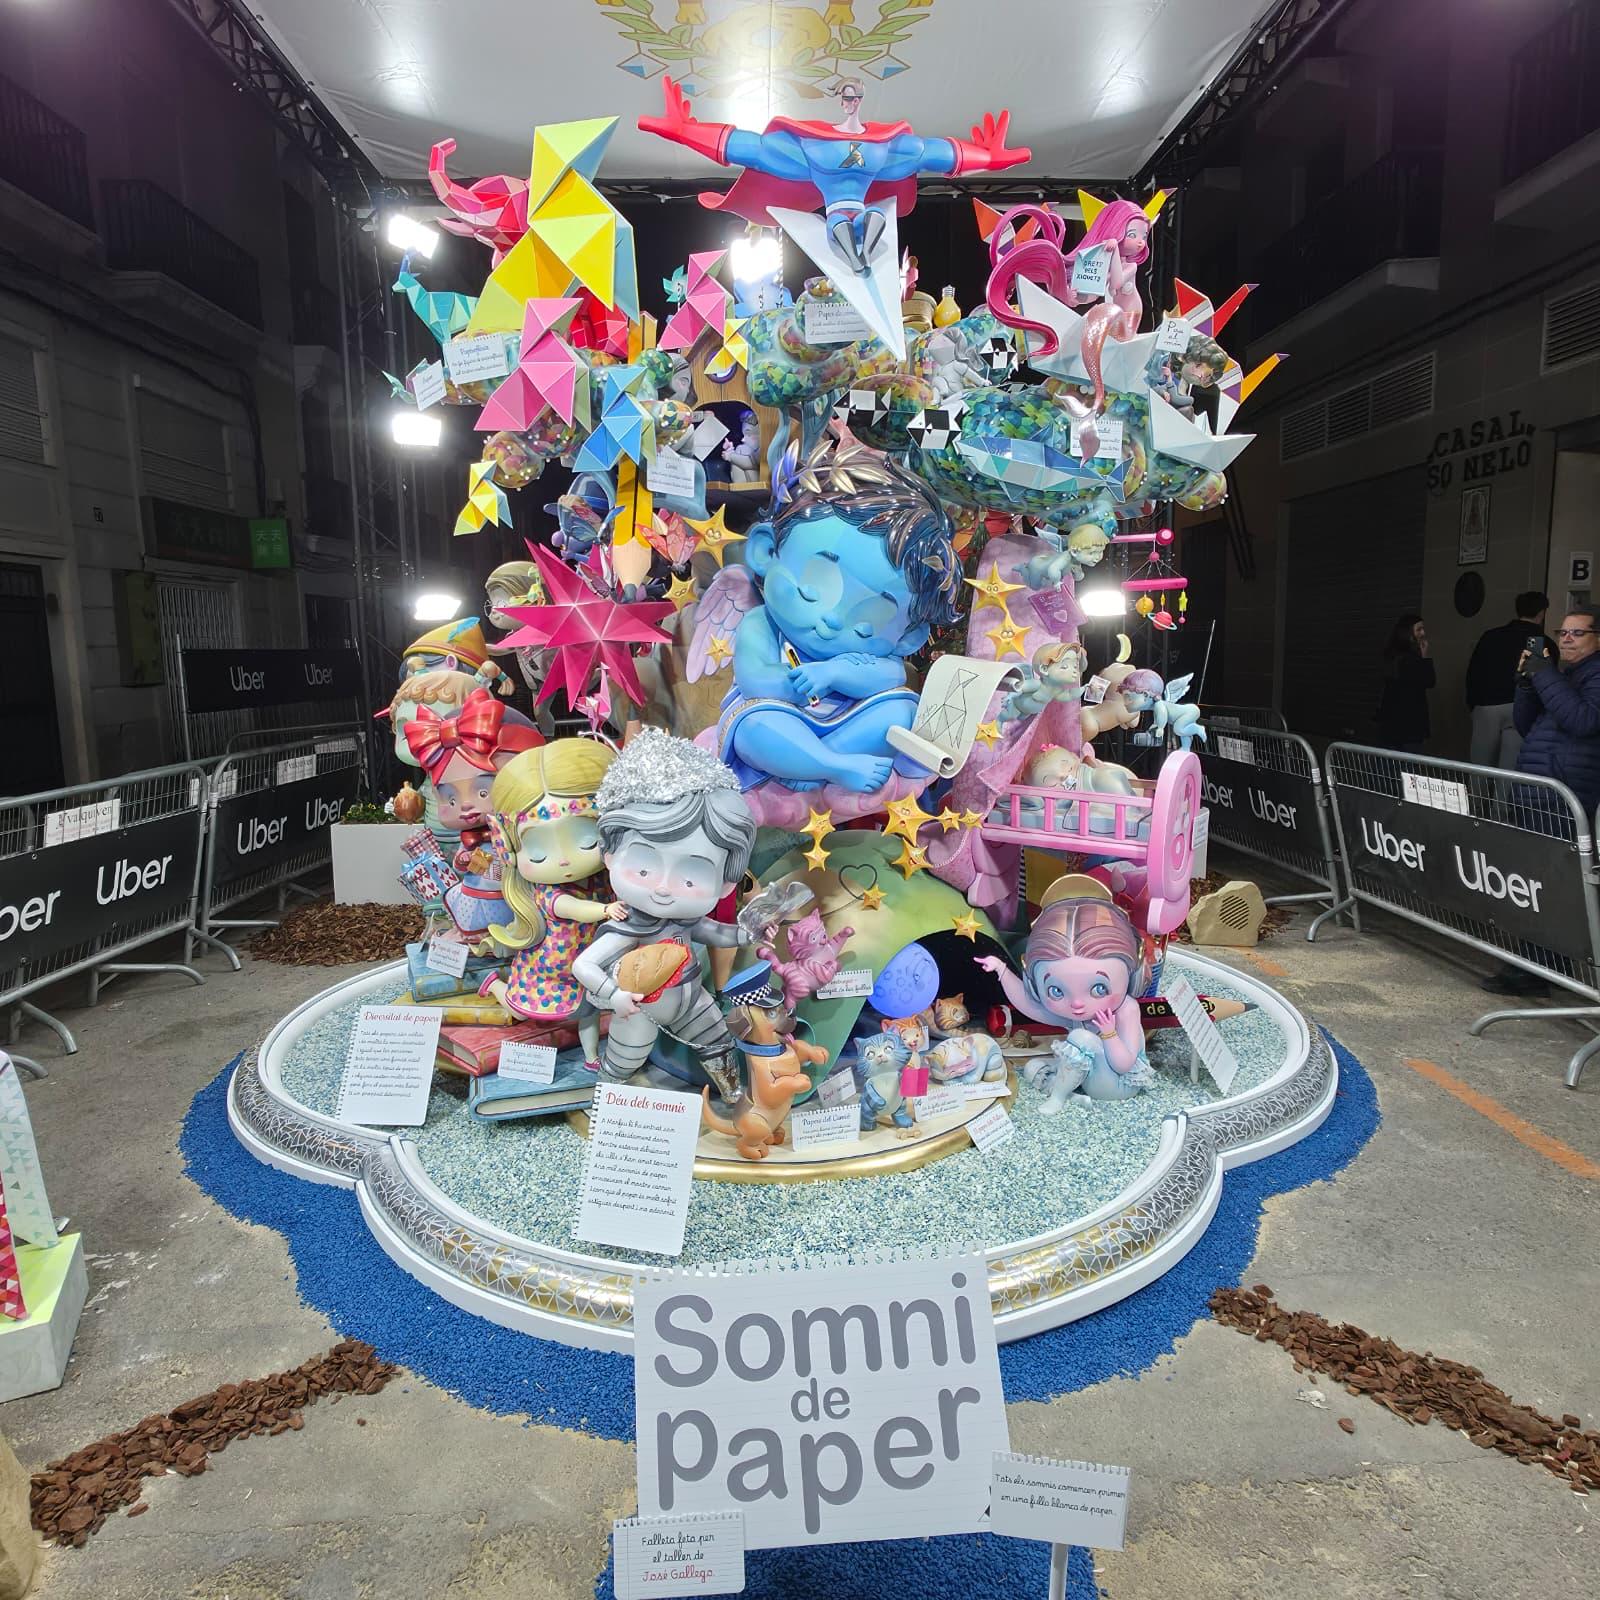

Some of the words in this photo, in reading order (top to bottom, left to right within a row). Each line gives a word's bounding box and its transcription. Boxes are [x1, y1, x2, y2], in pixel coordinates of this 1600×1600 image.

[1434, 410, 1527, 457] CASAL
[1571, 560, 1590, 581] B
[229, 665, 265, 691] Uber
[304, 663, 333, 686] Uber
[306, 797, 345, 831] Uber
[1248, 787, 1297, 830] Uber
[237, 816, 288, 855] Uber
[1361, 817, 1426, 872] Uber
[96, 855, 173, 905] Uber
[1454, 845, 1543, 913] Uber
[403, 1012, 413, 1021] de
[1146, 1003, 1166, 1015] de
[605, 1091, 628, 1106] Déu
[630, 1096, 650, 1110] dels
[652, 1100, 687, 1114] somnis
[653, 1271, 977, 1388] Somni
[790, 1377, 851, 1422] de
[656, 1386, 981, 1535] paper
[995, 1473, 1012, 1483] Tots
[1013, 1474, 1025, 1486] els
[1026, 1479, 1057, 1490] somnis
[1058, 1483, 1097, 1495] comencen
[1098, 1487, 1126, 1499] primer
[1029, 1494, 1050, 1509] fulla
[1051, 1497, 1079, 1511] blanca
[1080, 1502, 1089, 1512] de
[641, 1533, 676, 1546] Falleta
[676, 1530, 696, 1548] feta
[697, 1533, 715, 1546] per
[652, 1550, 662, 1563] el
[664, 1548, 692, 1562] taller
[693, 1549, 704, 1560] de
[642, 1568, 668, 1583] José
[670, 1564, 713, 1584] Gallego
